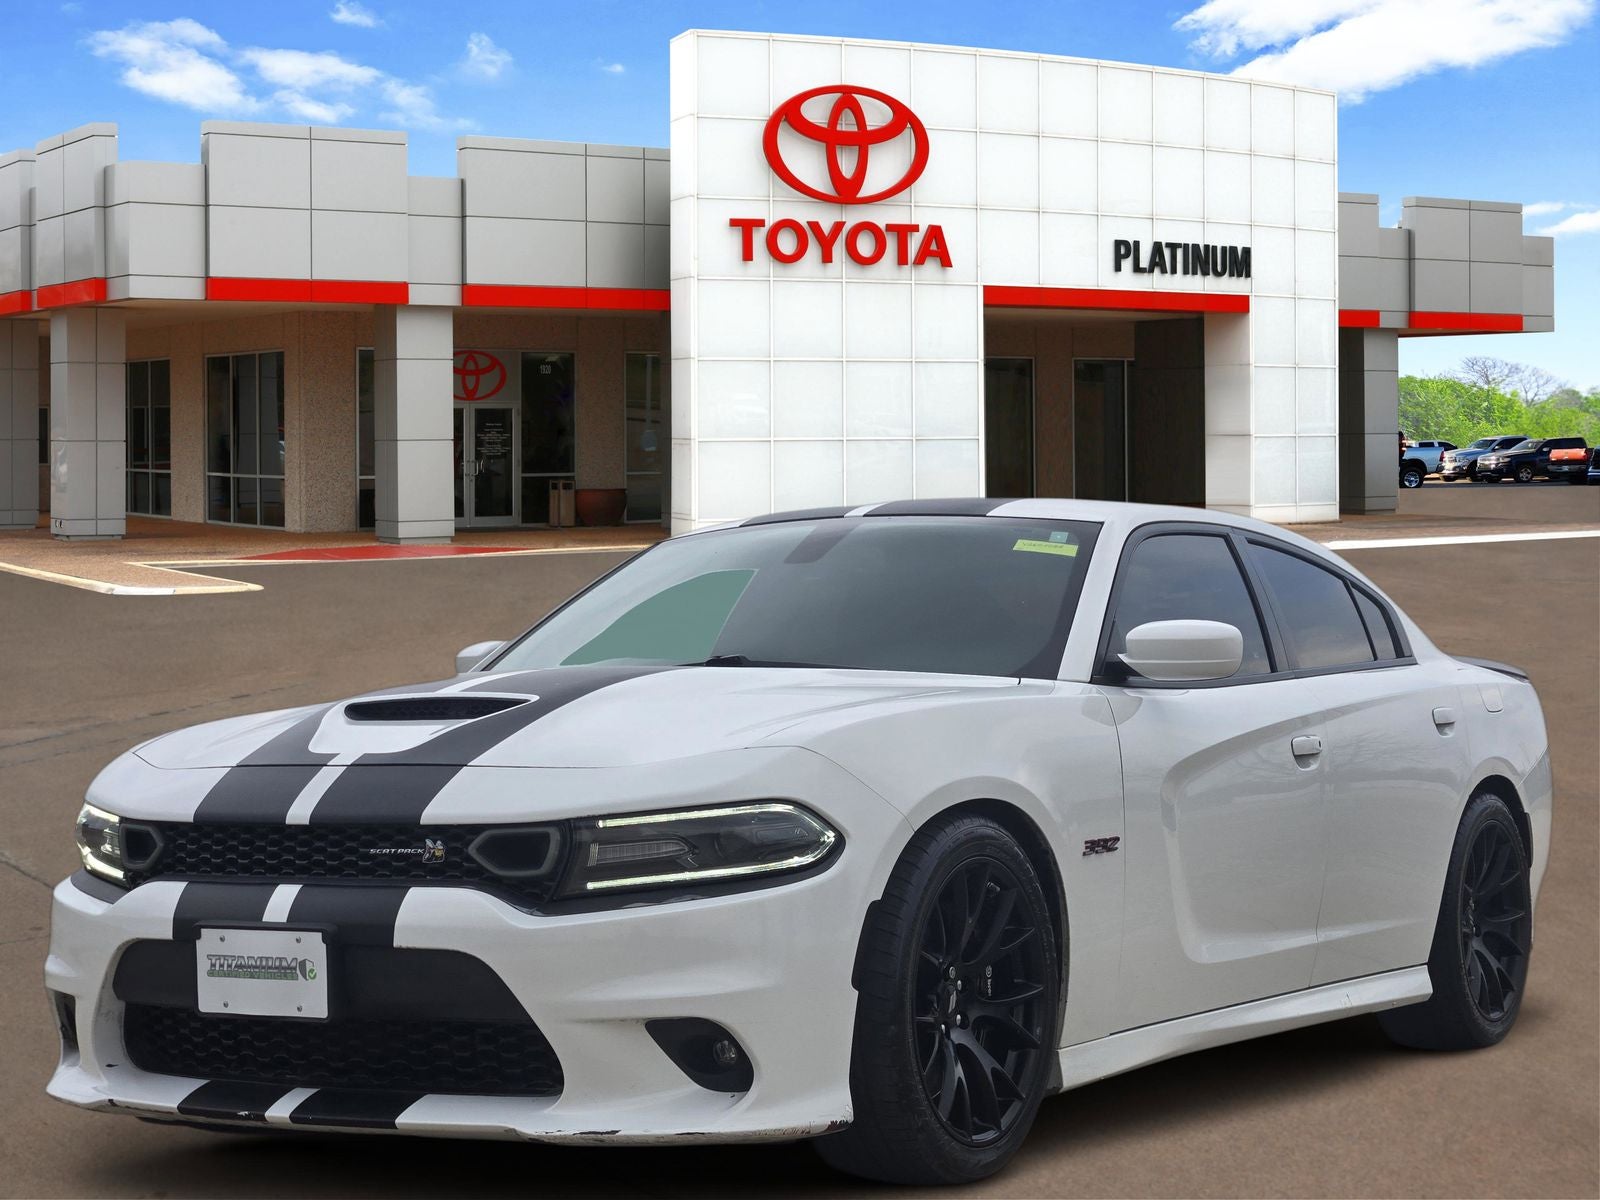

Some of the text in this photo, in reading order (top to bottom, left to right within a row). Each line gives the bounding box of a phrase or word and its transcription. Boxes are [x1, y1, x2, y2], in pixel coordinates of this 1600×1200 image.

[729, 218, 953, 268] TOYOTA
[1114, 239, 1251, 278] PLATINUM
[206, 954, 299, 972] TITANIUM
